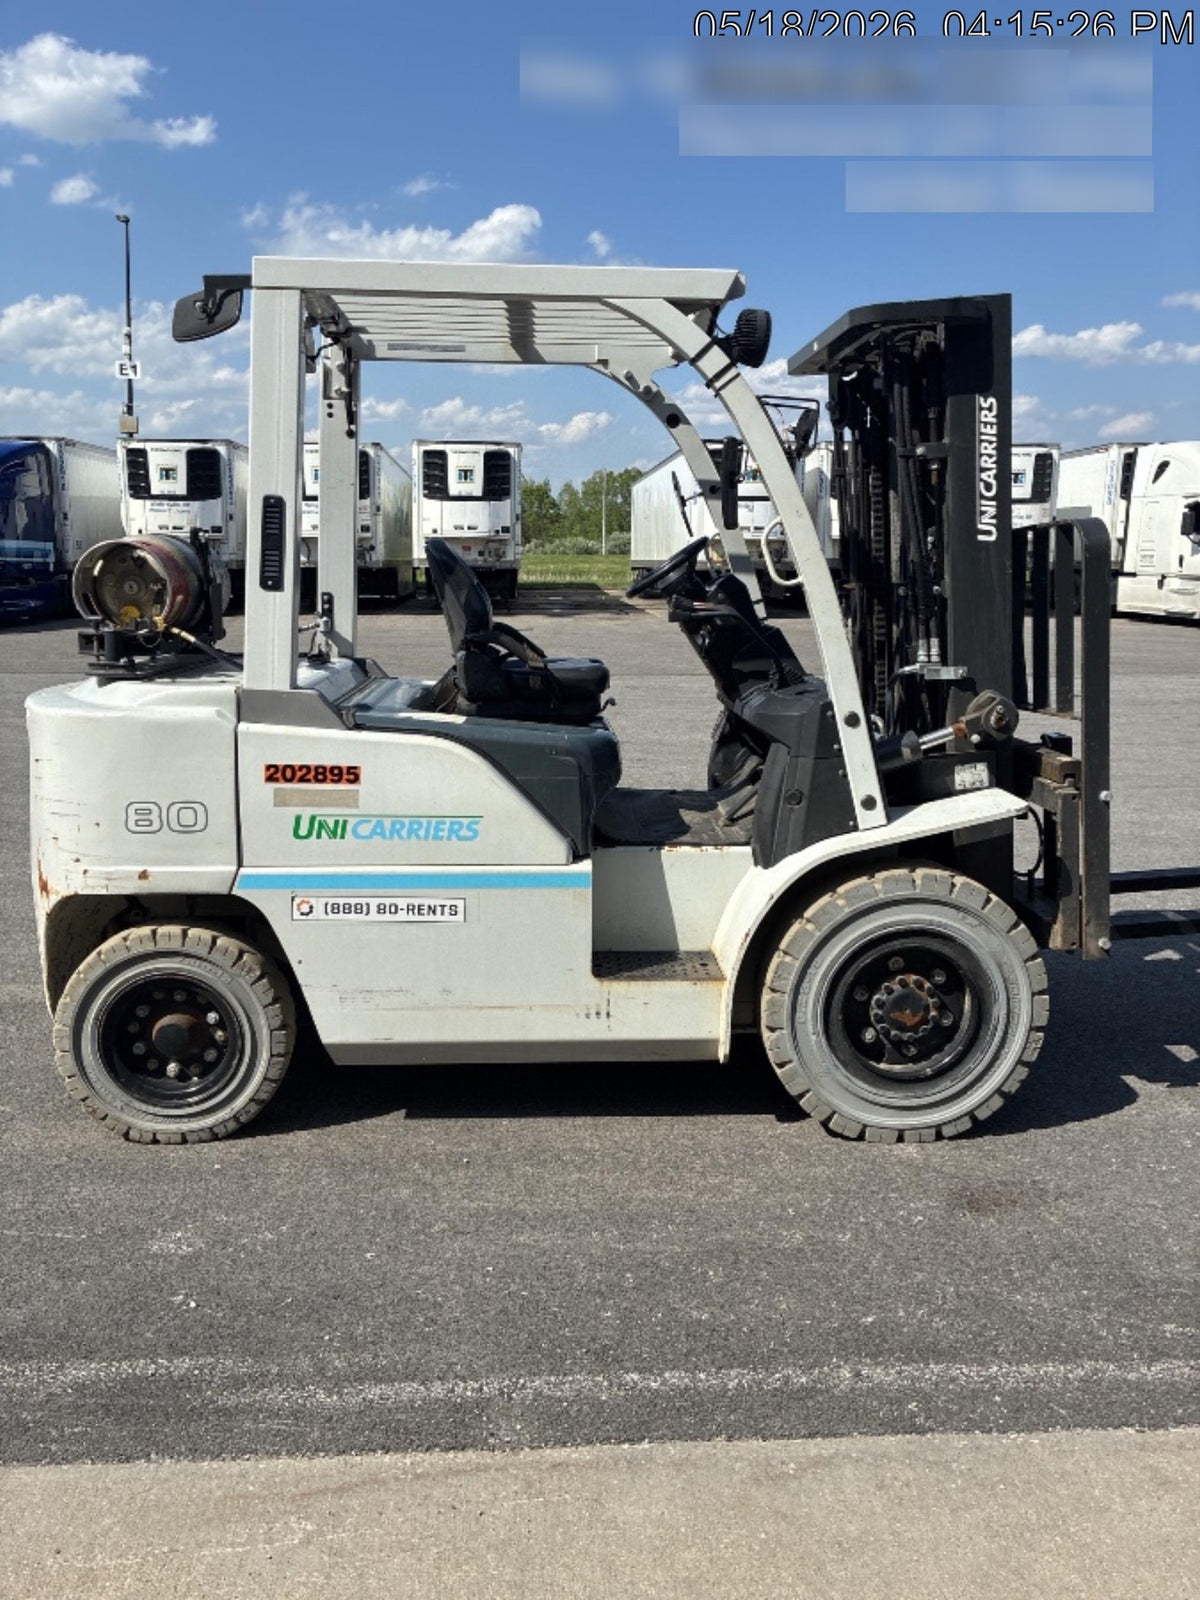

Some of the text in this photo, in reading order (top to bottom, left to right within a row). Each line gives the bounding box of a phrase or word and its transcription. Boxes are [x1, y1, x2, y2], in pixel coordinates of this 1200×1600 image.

[976, 395, 998, 541] UNICARRIERS
[265, 765, 360, 783] 202895
[125, 801, 208, 834] 80
[292, 814, 481, 841] UNICARRIERS
[324, 902, 458, 917] (888) 80-RENTS
